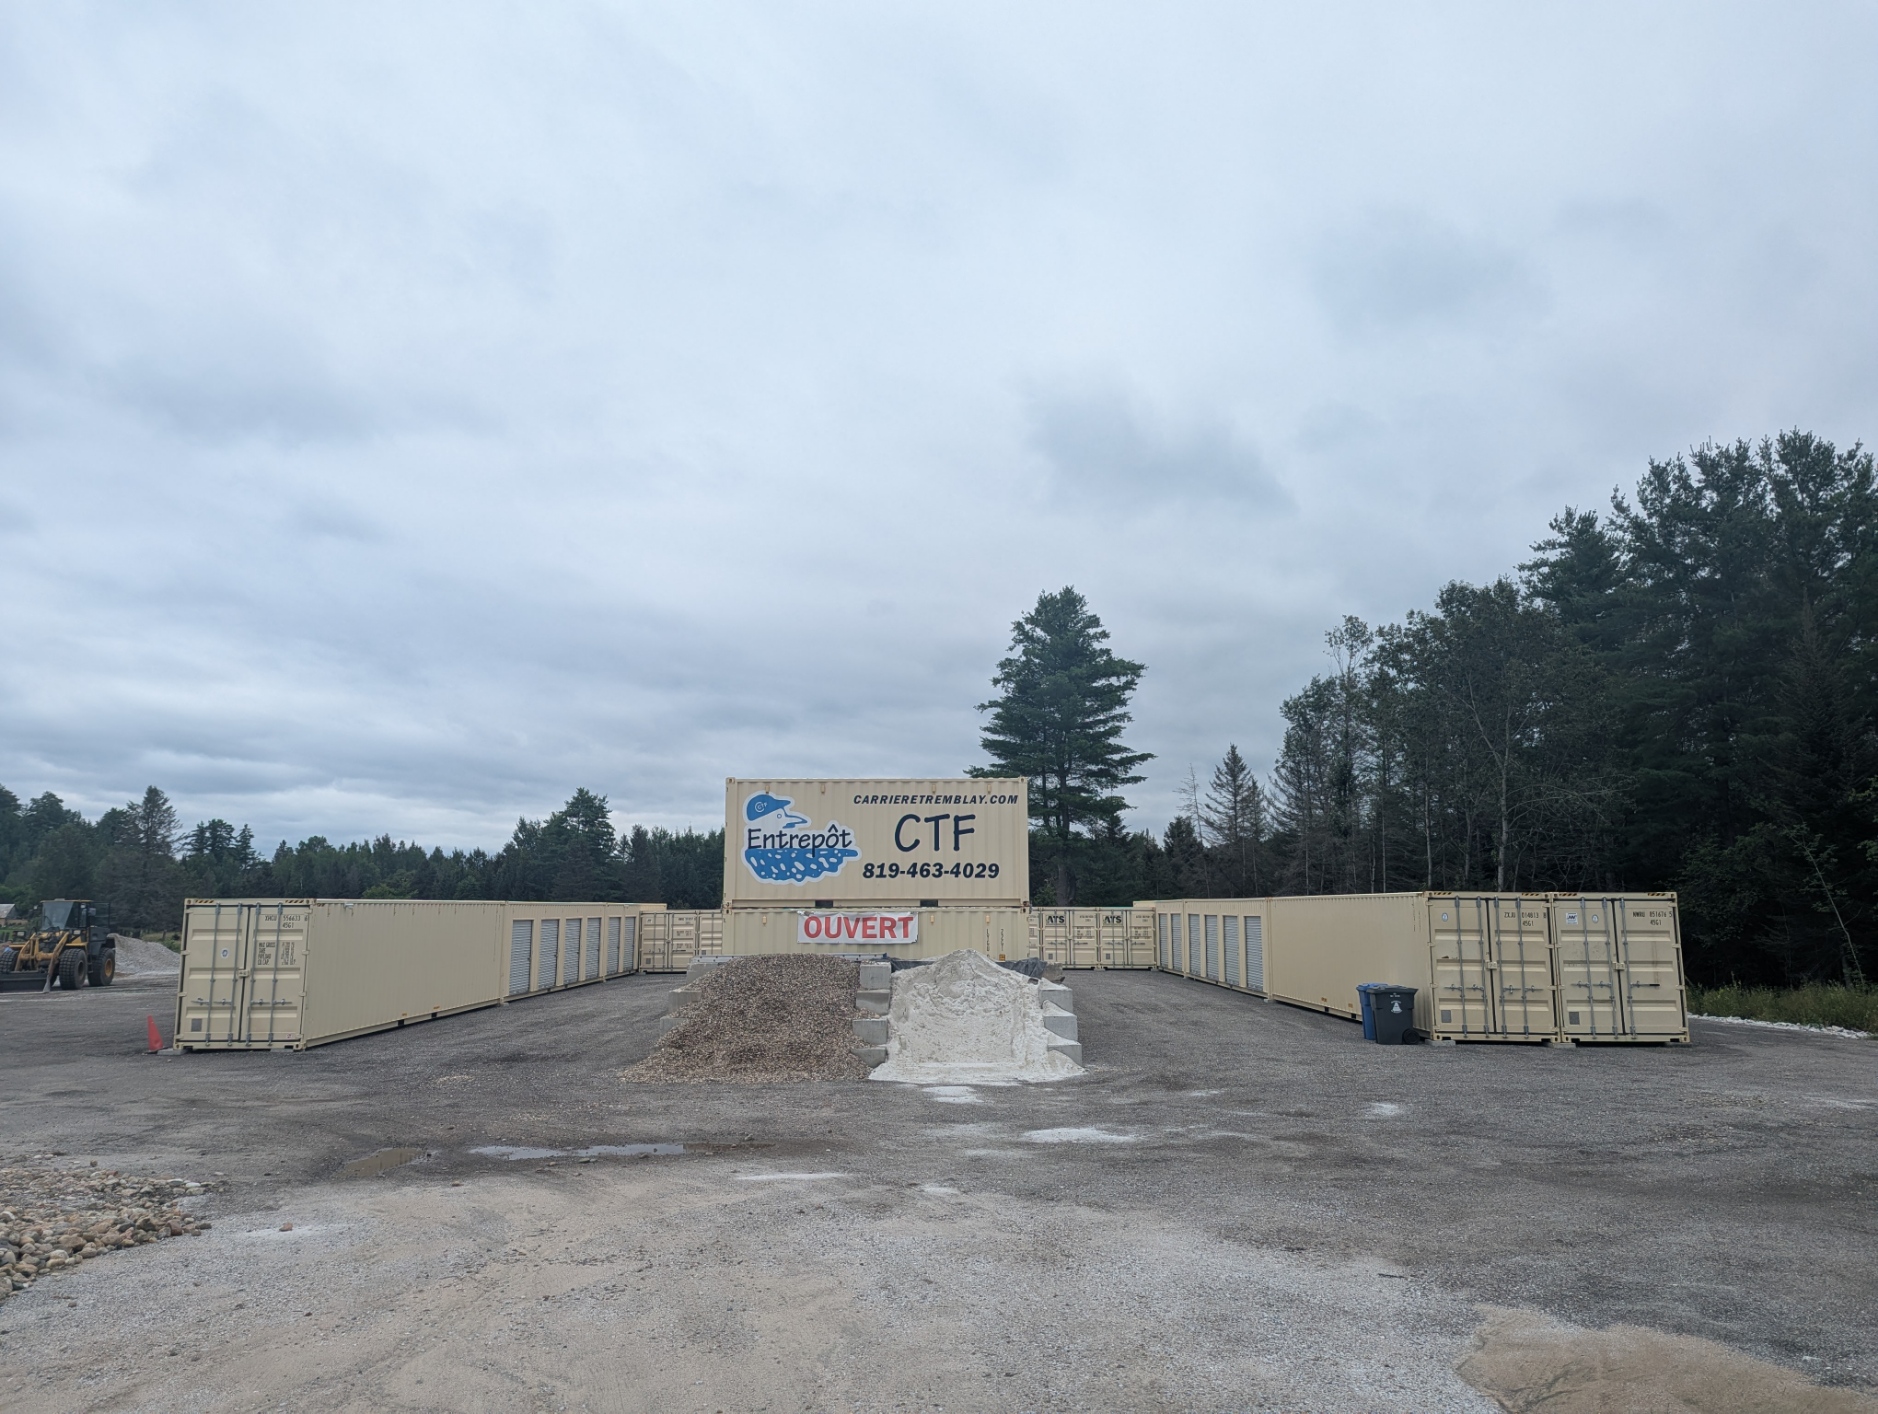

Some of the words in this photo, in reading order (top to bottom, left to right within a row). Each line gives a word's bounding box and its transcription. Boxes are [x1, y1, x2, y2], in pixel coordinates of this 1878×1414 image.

[853, 794, 1018, 805] CARRIERETREMBLAY.COM
[748, 824, 852, 857] Entrepôt
[895, 813, 976, 852] CTF
[862, 862, 1000, 879] 819-463-4029
[804, 916, 914, 939] OUVERT
